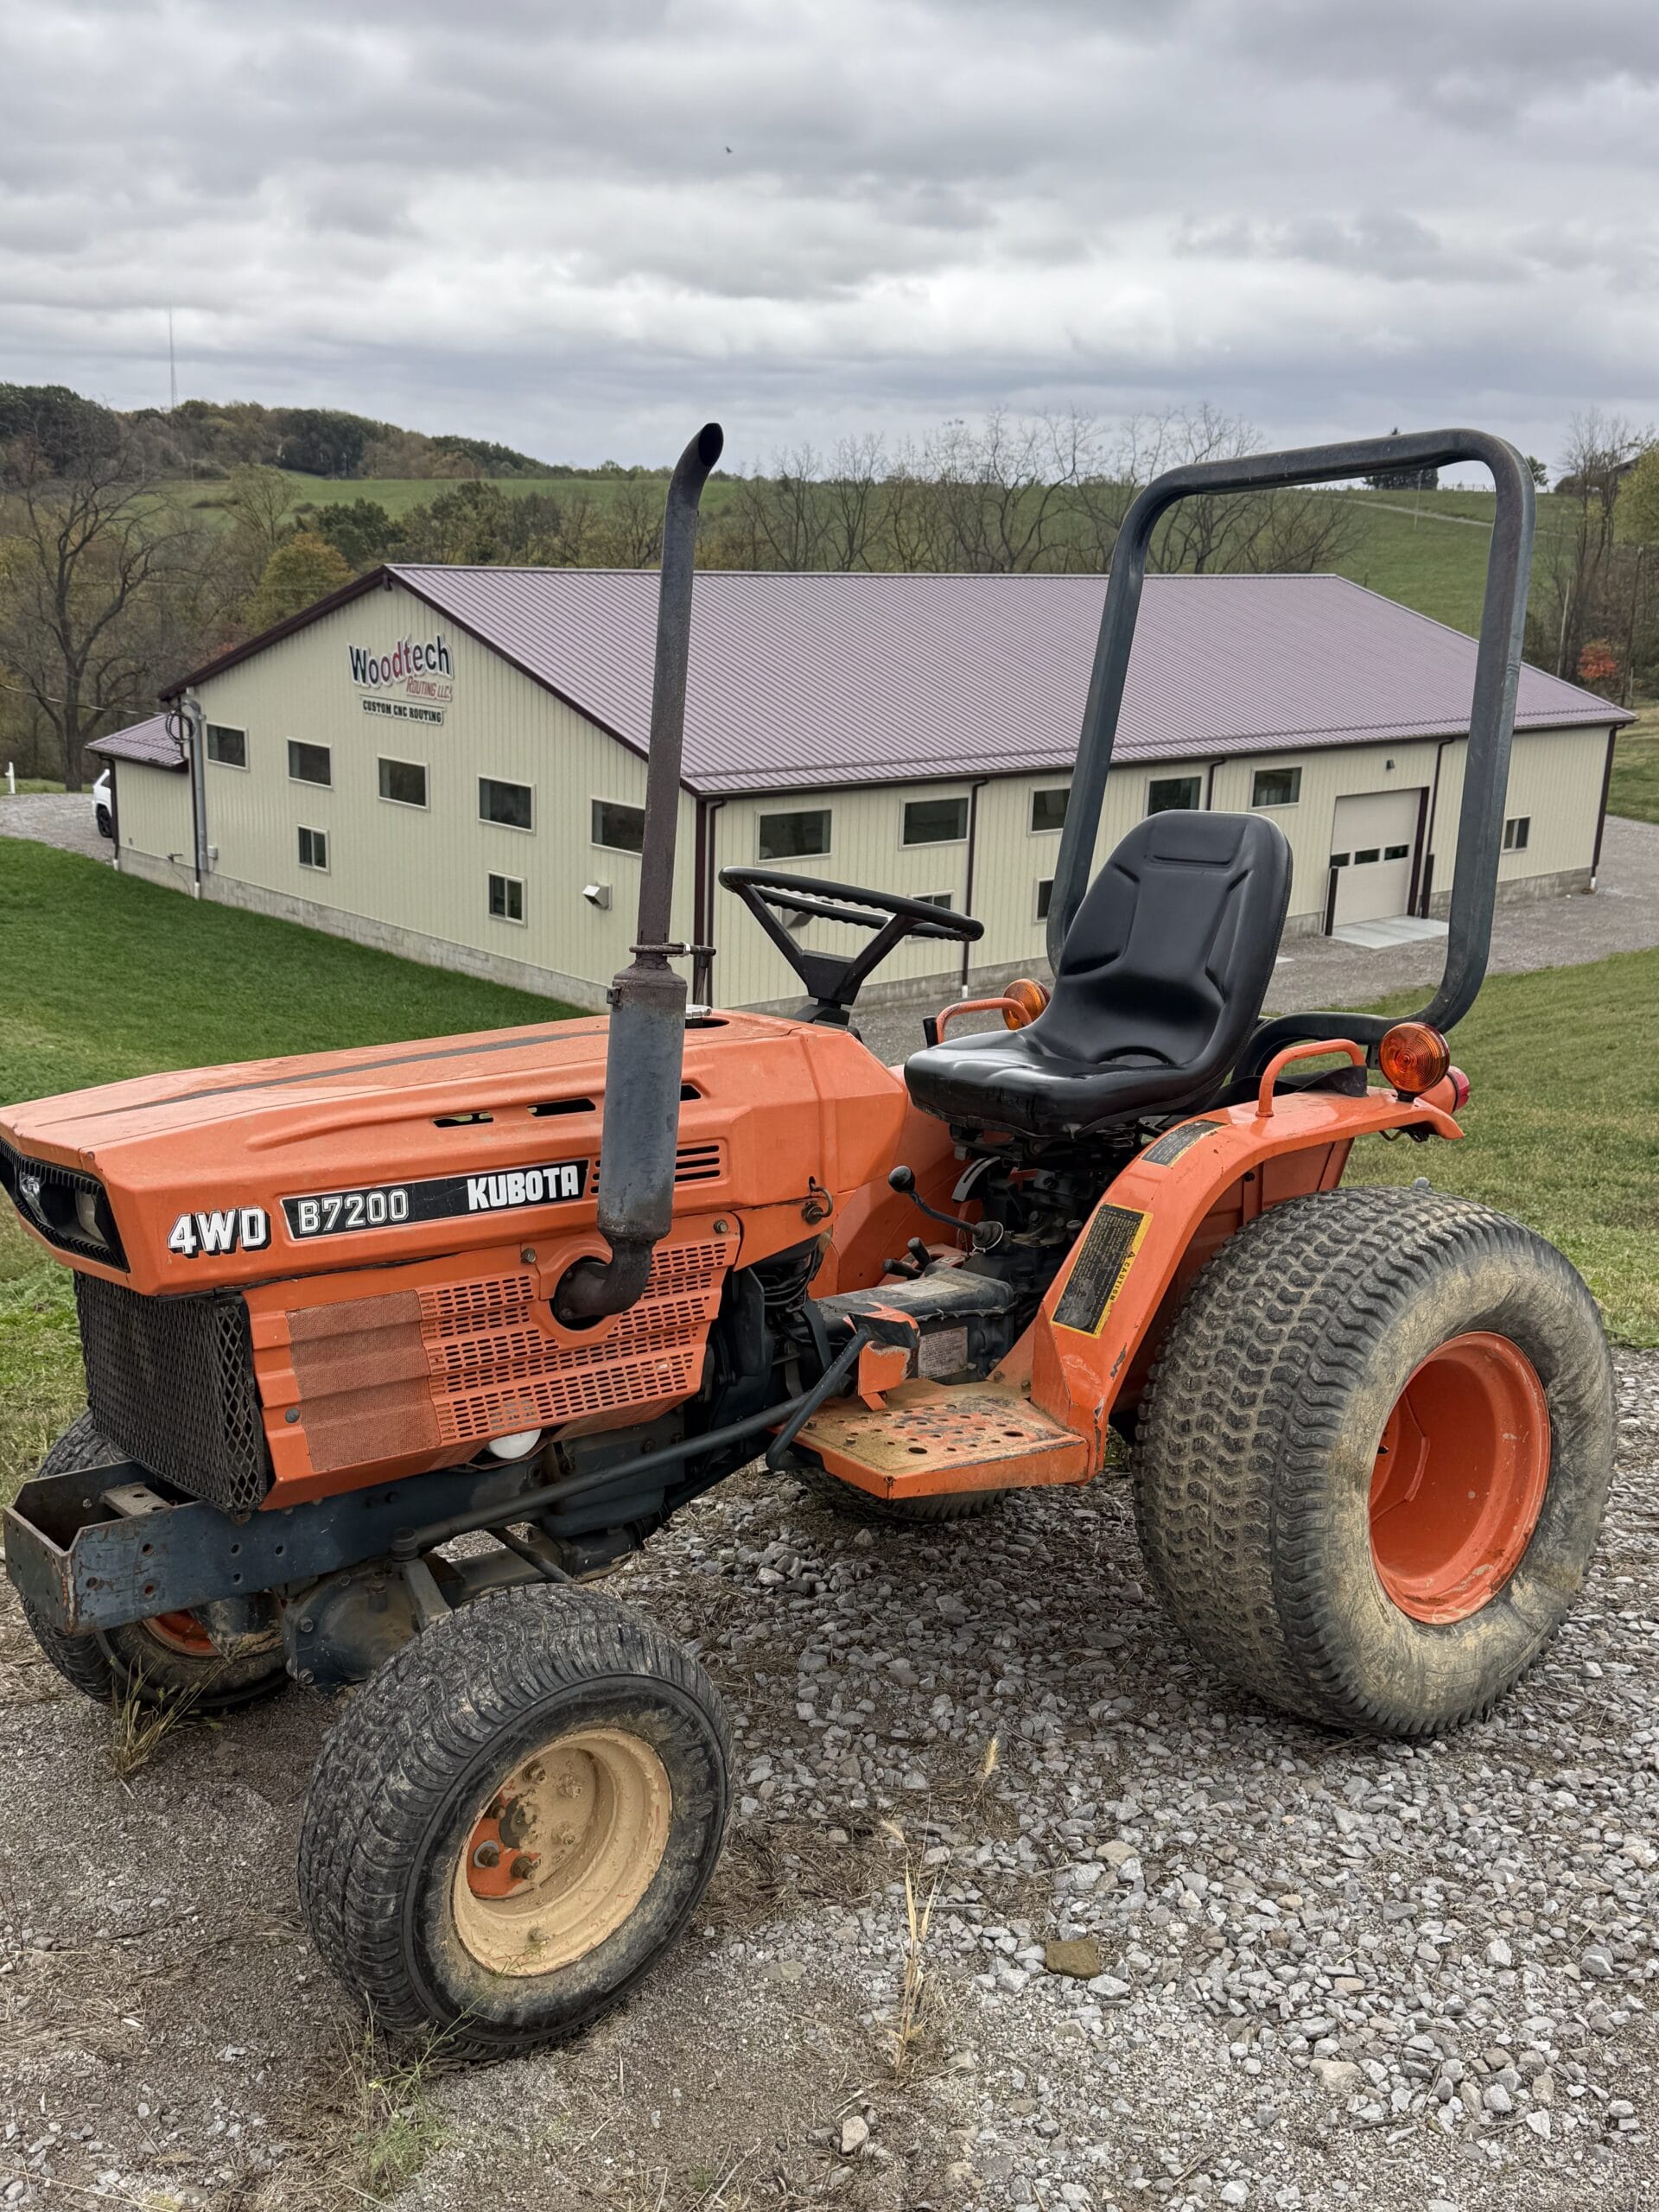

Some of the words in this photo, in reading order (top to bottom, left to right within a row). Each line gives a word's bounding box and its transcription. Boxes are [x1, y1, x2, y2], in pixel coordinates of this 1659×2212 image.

[348, 635, 450, 684] Woodtech
[363, 700, 391, 715] CUSTOM
[393, 704, 408, 717] CNC
[410, 707, 442, 723] ROUTING
[297, 1189, 410, 1234] B7200
[467, 1165, 580, 1211] KUBOTA
[168, 1207, 271, 1258] 4WD
[1109, 1262, 1130, 1301] CAUTION
